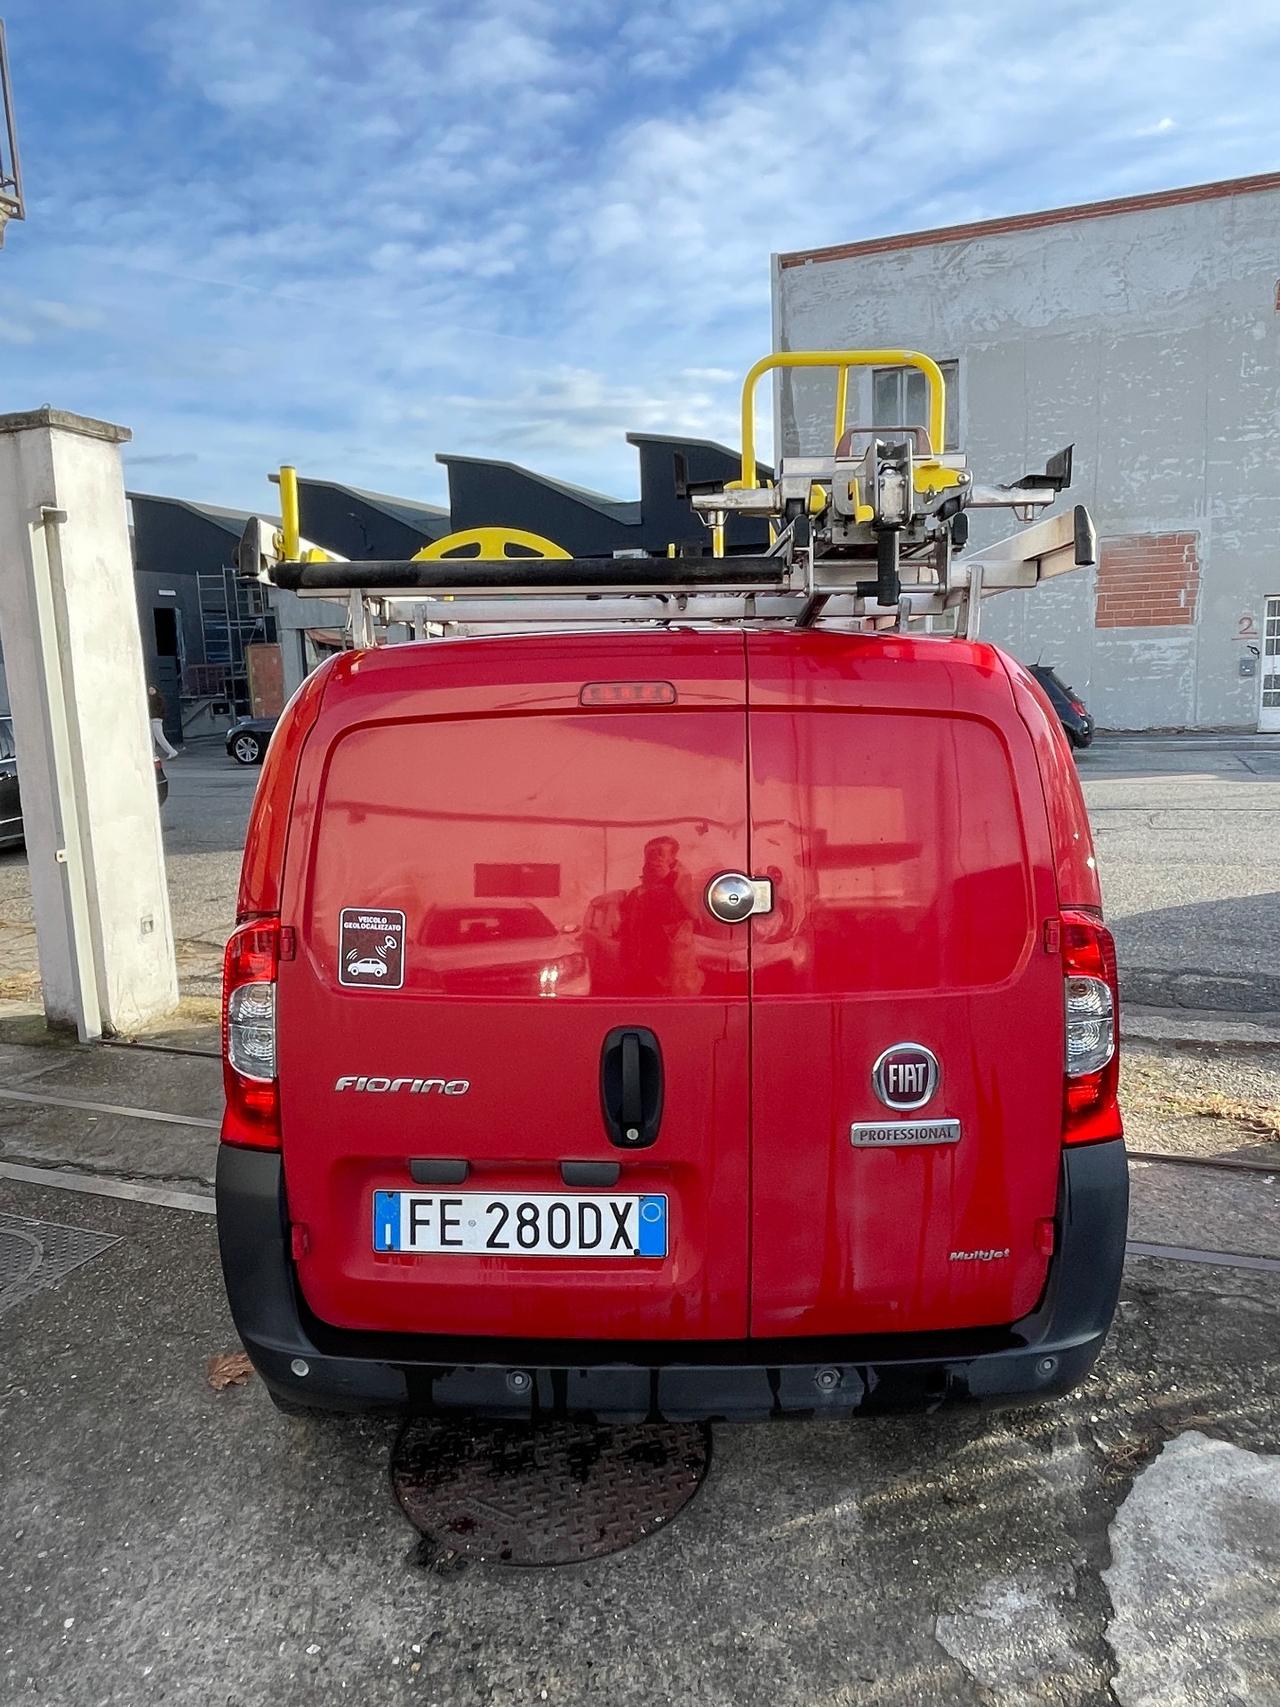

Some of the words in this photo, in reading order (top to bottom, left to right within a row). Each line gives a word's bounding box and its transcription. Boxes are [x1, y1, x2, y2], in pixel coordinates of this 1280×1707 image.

[1238, 616, 1257, 635] 2
[343, 922, 402, 931] GEOLOCALIZZATO
[358, 916, 388, 924] VEICOLO
[888, 1063, 927, 1093] FIAT
[859, 1127, 954, 1141] PROFESSIONAL
[409, 1199, 463, 1246] FE
[485, 1201, 633, 1249] 280DX
